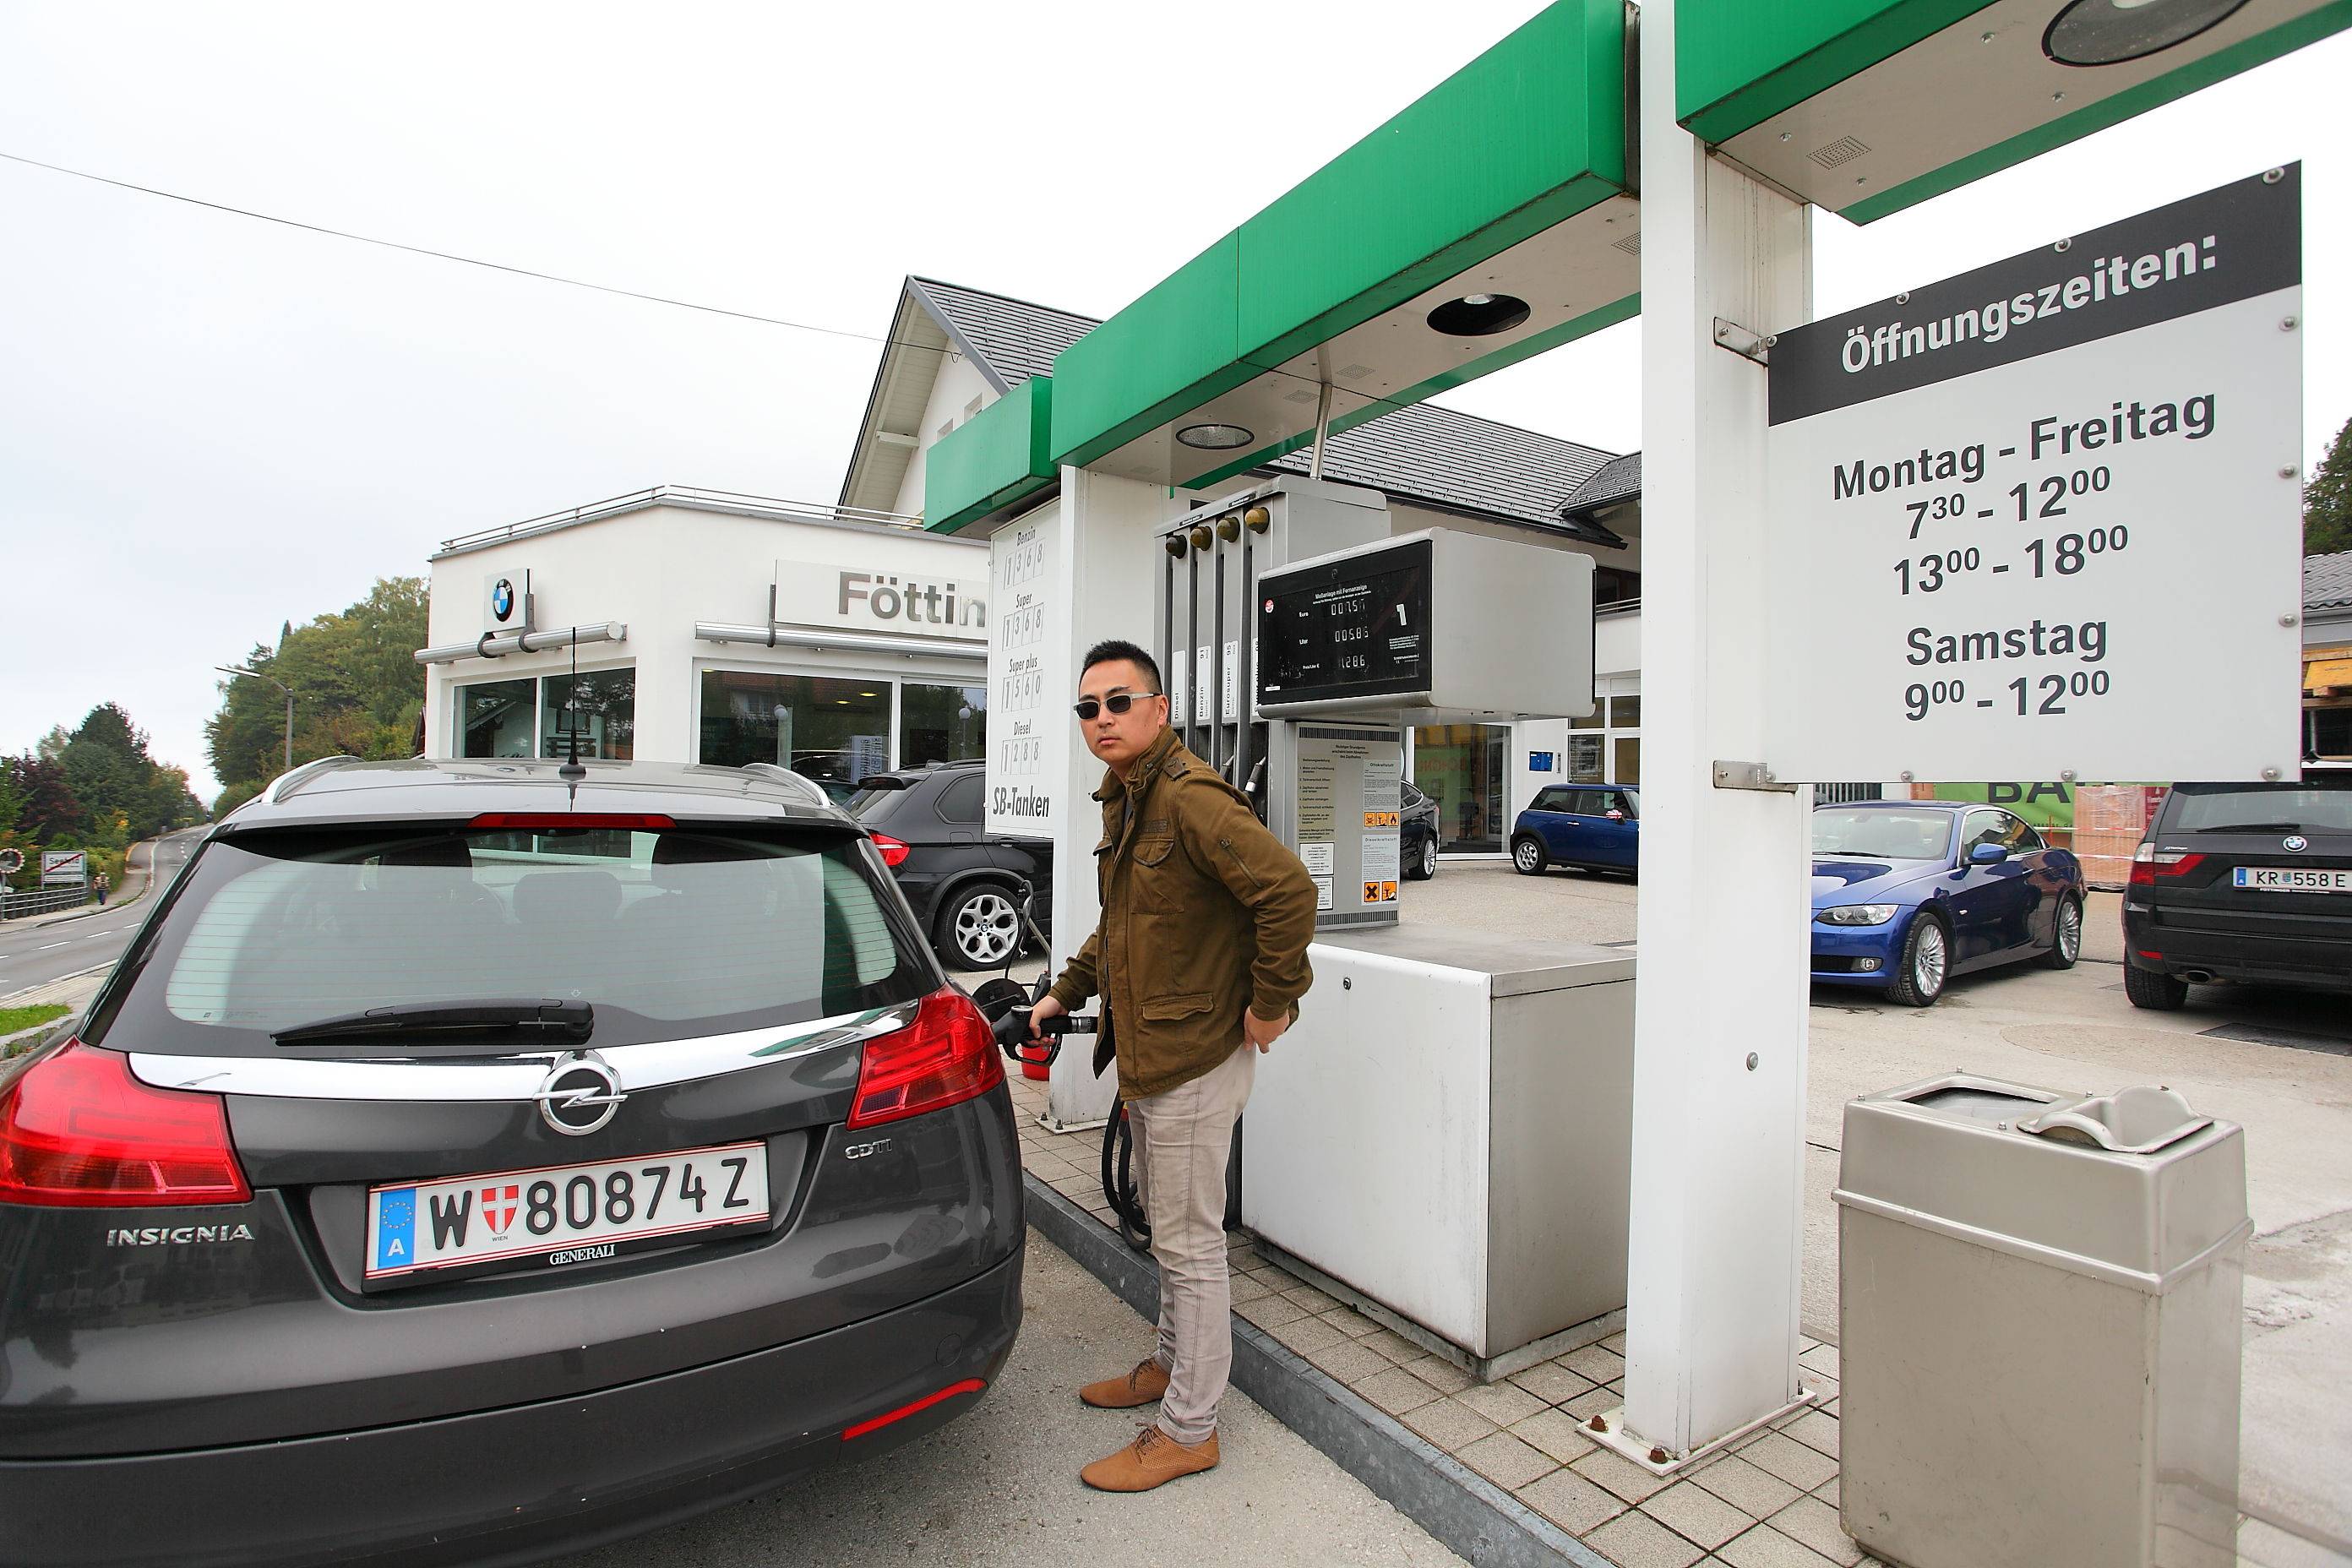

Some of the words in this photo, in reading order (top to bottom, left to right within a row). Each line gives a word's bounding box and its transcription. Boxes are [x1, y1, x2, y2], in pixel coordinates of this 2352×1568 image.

[1842, 235, 2217, 374] Öffnungszeiten:
[1833, 444, 1985, 500] Montag
[2030, 393, 2216, 461] Freitag
[1017, 526, 1036, 547] Benzin
[1006, 543, 1043, 585] 1368
[1016, 593, 1032, 609] Super
[1396, 603, 1407, 626] 1
[1005, 609, 1042, 647] 1368
[1227, 645, 1232, 656] 95
[1906, 618, 2108, 665] Samstag
[1010, 658, 1025, 675] Super
[1026, 653, 1037, 672] plus
[1200, 650, 1205, 659] 91
[1005, 676, 1040, 710] 1560
[1014, 718, 1032, 735] Diesel
[1004, 741, 1039, 772] 1288
[993, 786, 1049, 817] SB-Tanken
[2257, 871, 2278, 885] KR
[2294, 873, 2329, 886] 558
[2335, 874, 2345, 887] E
[845, 1138, 893, 1160] CDTI
[388, 1238, 405, 1257] A
[429, 1190, 473, 1251] W
[106, 1224, 255, 1247] INSIGNIA
[549, 1244, 615, 1265] GENERALI
